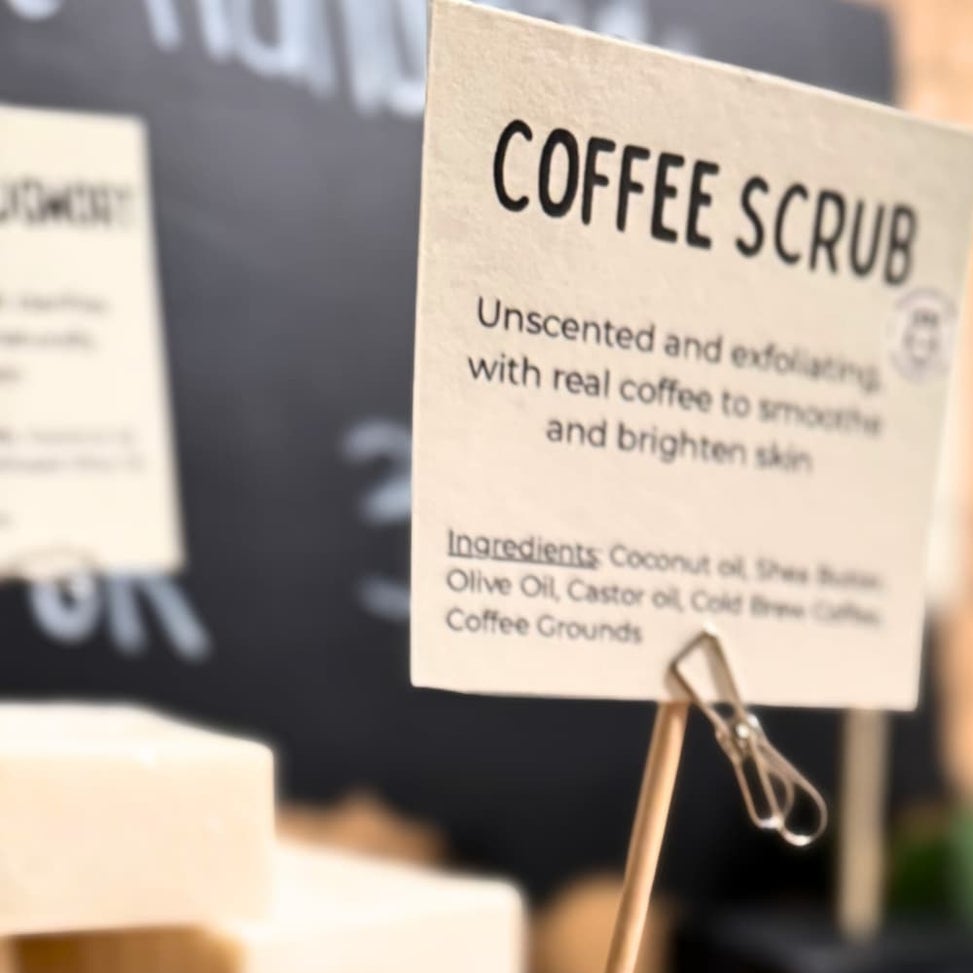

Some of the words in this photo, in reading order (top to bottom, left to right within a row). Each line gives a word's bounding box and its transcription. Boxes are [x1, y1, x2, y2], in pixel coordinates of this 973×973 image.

[493, 119, 720, 250] COFFEE
[735, 176, 918, 286] SCRUB
[477, 295, 656, 352] Unscented
[664, 332, 723, 364] and
[467, 353, 541, 388] with
[553, 368, 610, 399] real
[619, 376, 713, 413] coffee
[722, 389, 751, 418] to
[758, 398, 884, 437] smoothe
[546, 418, 608, 448] and
[617, 421, 746, 463] brighten
[756, 436, 813, 476] skin
[609, 543, 710, 576] Coconut
[755, 556, 808, 585] Shea
[446, 568, 512, 596] Olive
[520, 574, 560, 603] Oil,
[566, 578, 645, 607] Castor
[651, 587, 684, 613] oil,
[689, 589, 743, 617] Cold
[749, 594, 806, 620] Brew
[446, 607, 530, 634] Coffee
[537, 614, 644, 646] Grounds
